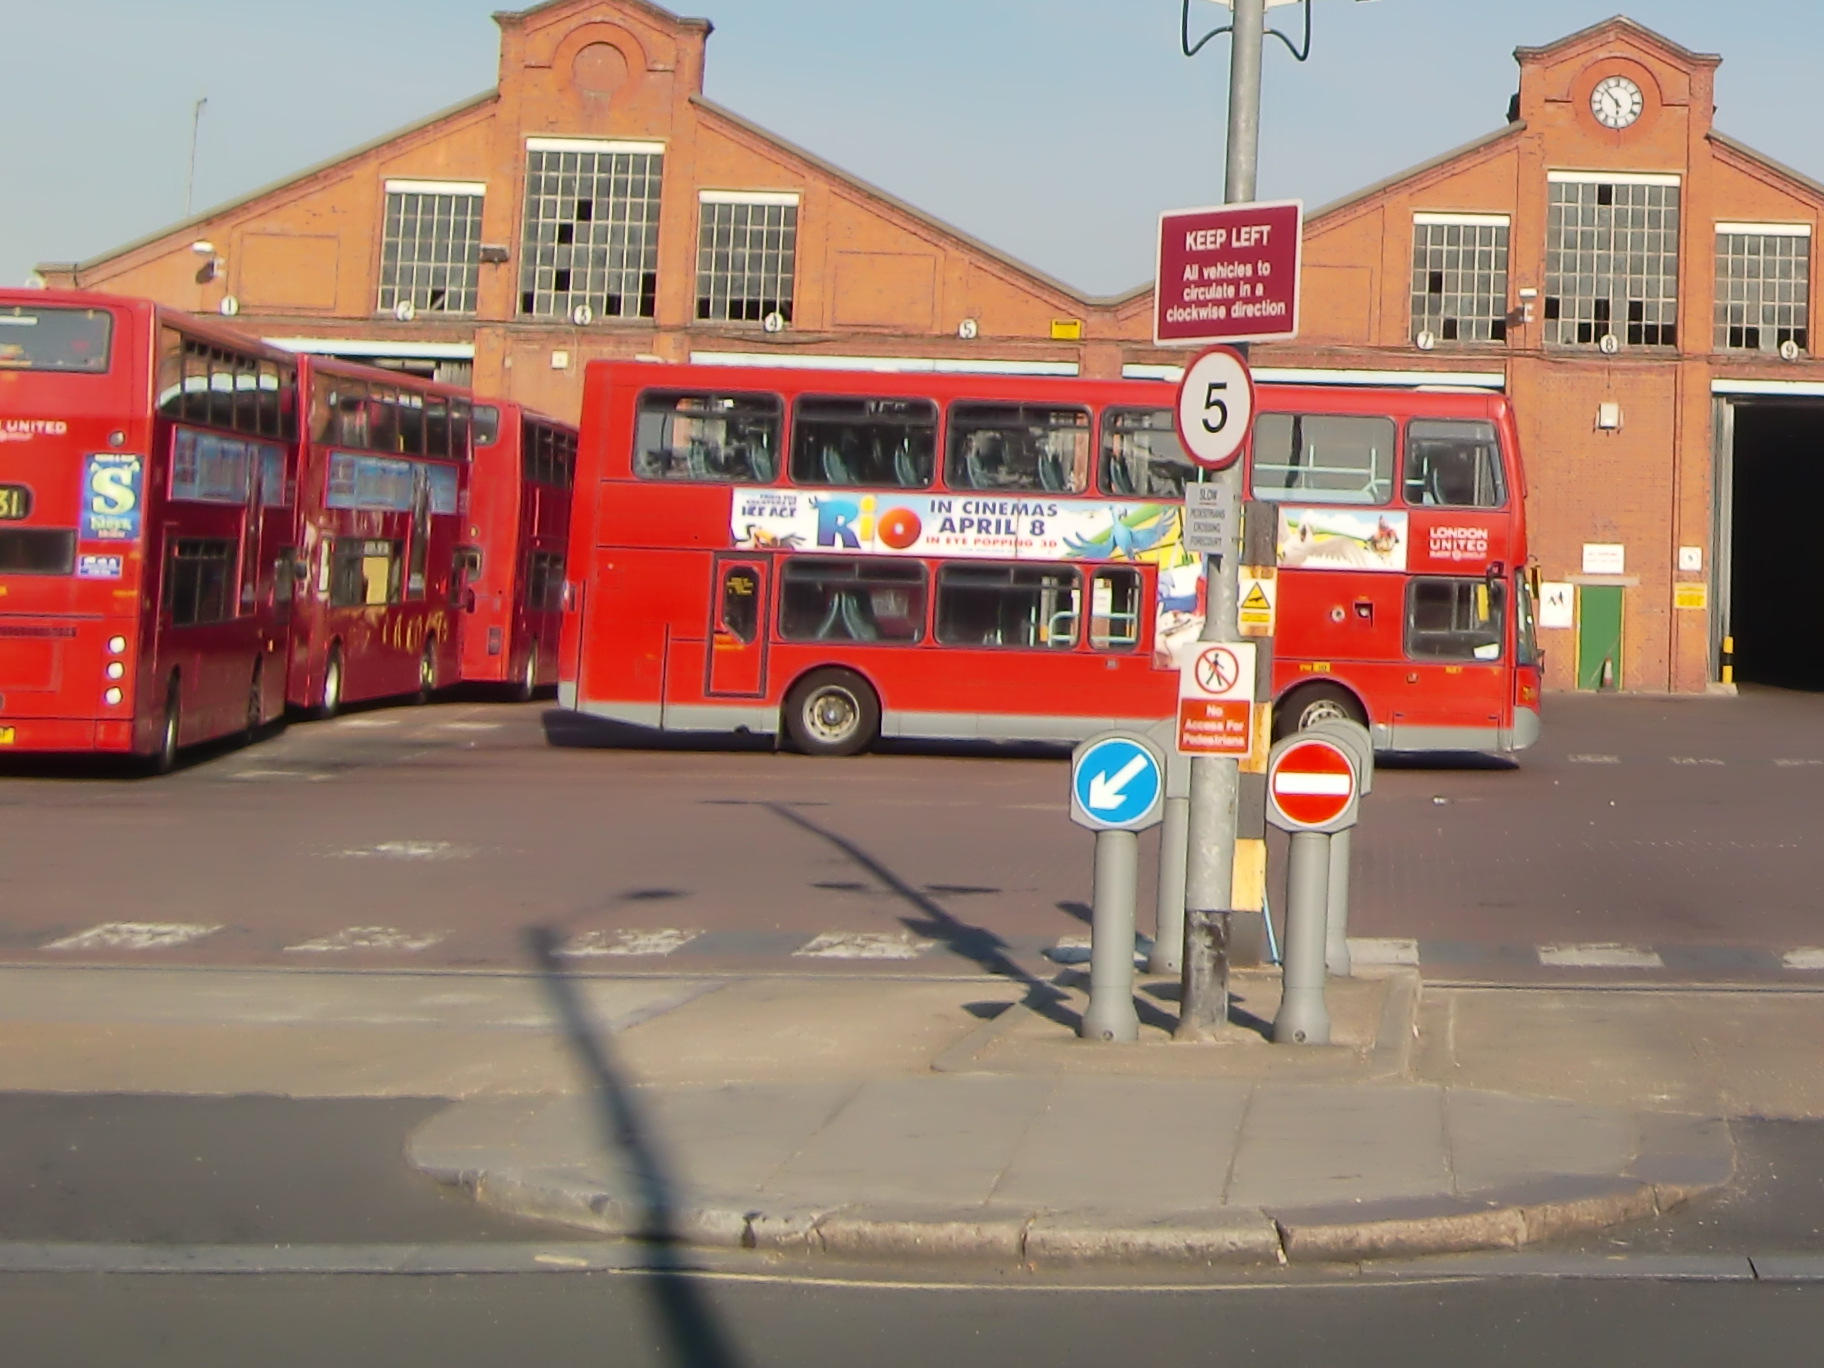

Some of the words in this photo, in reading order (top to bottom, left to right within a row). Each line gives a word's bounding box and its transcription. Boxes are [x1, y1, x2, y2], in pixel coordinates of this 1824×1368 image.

[1185, 228, 1226, 252] KEEP
[1231, 225, 1272, 248] LEFT
[1183, 264, 1199, 281] All
[1203, 261, 1253, 280] vehicles
[1257, 259, 1271, 276] to
[1183, 283, 1235, 302] circulate
[1239, 280, 1251, 297] in
[1255, 282, 1264, 296] a
[1166, 302, 1226, 323] clockwise
[1230, 299, 1286, 318] direction
[769, 315, 778, 329] 4
[963, 321, 973, 335] 5
[1421, 333, 1431, 347] 7
[1605, 337, 1614, 351] 8
[1785, 343, 1794, 356] 9
[1202, 382, 1228, 433] 5
[7, 420, 67, 434] UNITED
[91, 466, 136, 515] S
[1200, 488, 1217, 500] SLOW
[930, 499, 952, 514] IN
[962, 501, 1058, 517] CINEMAS
[939, 517, 1018, 535] APRIL
[1029, 519, 1045, 536] 8
[1429, 526, 1488, 539] LONDON
[926, 536, 940, 544] IN
[946, 537, 967, 546] EYE
[973, 538, 1033, 547] POPPING
[1041, 539, 1057, 548] 3D
[1429, 539, 1487, 551] UNITED
[1205, 704, 1223, 717] No
[1184, 719, 1224, 731] Access
[1226, 720, 1244, 732] For
[1183, 733, 1245, 747] Pedestrians
